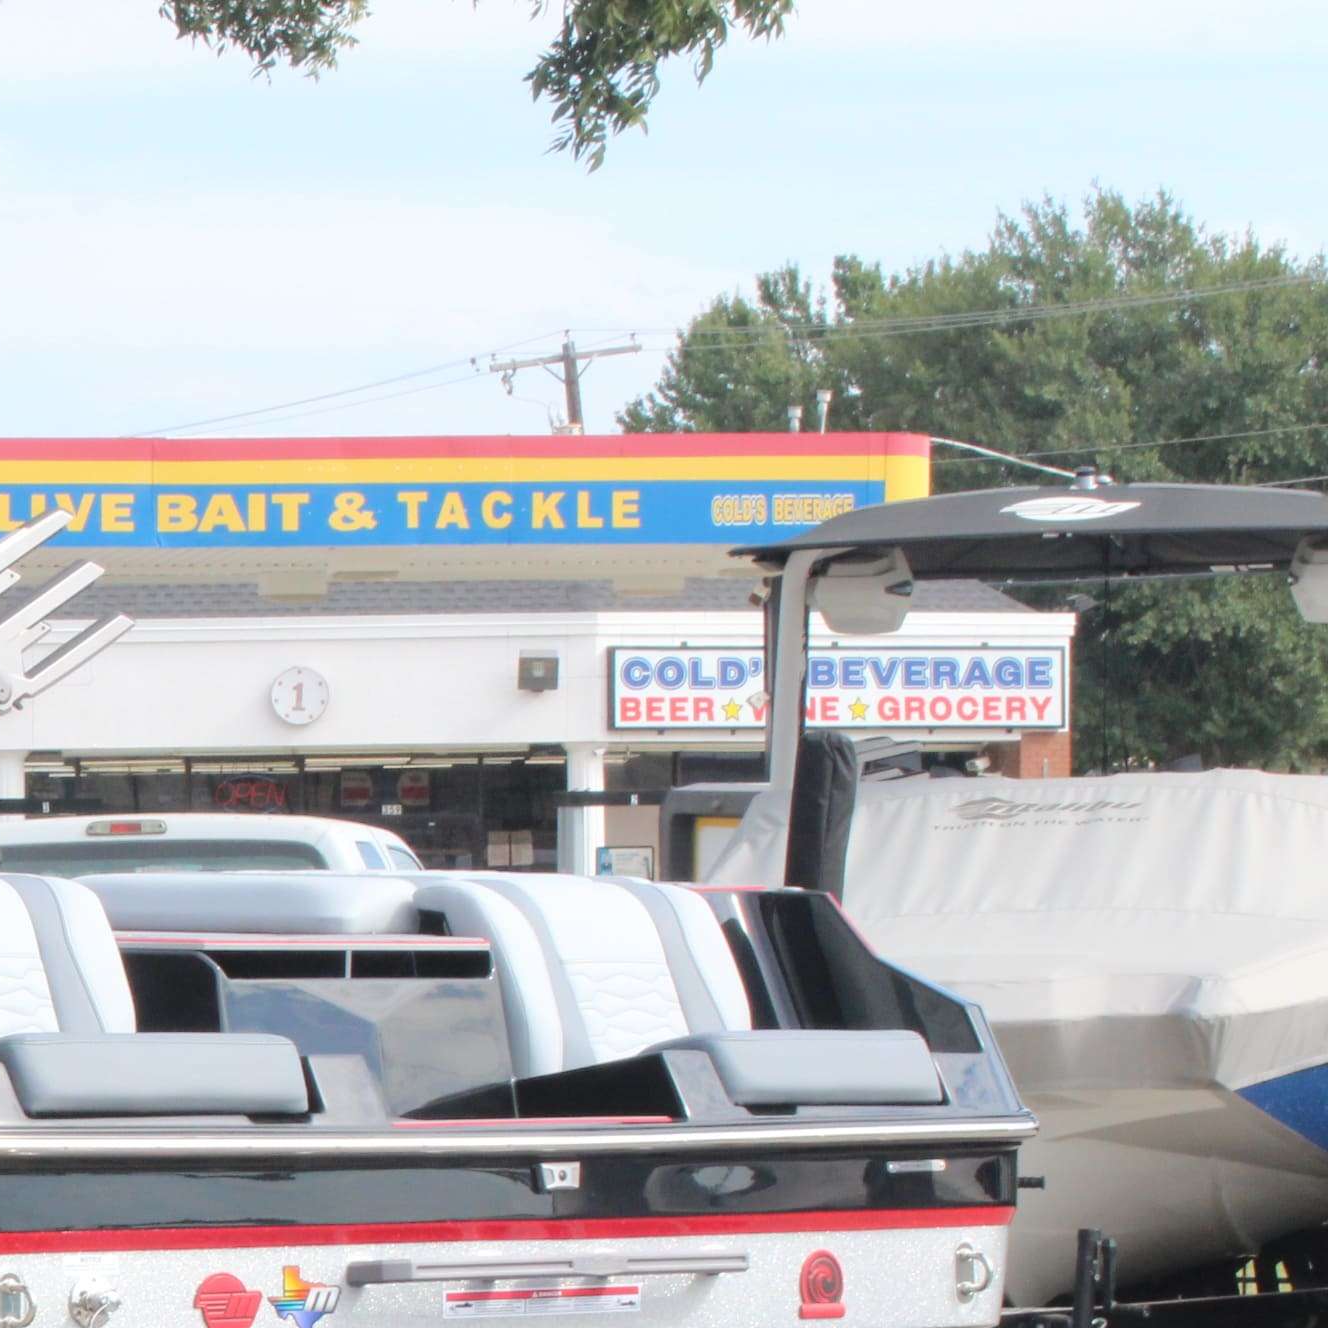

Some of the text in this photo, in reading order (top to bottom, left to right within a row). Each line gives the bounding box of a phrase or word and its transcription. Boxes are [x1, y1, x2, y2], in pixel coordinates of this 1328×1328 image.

[157, 493, 311, 532] BAIT
[328, 491, 378, 531] &
[397, 490, 642, 529] TACKLE
[712, 494, 769, 526] COLD'S
[620, 656, 1053, 690] COLD' BEVERAGE
[291, 682, 306, 711] 1
[620, 696, 715, 722] BEER
[877, 695, 1053, 722] GROCERY
[216, 782, 288, 807] OPEN
